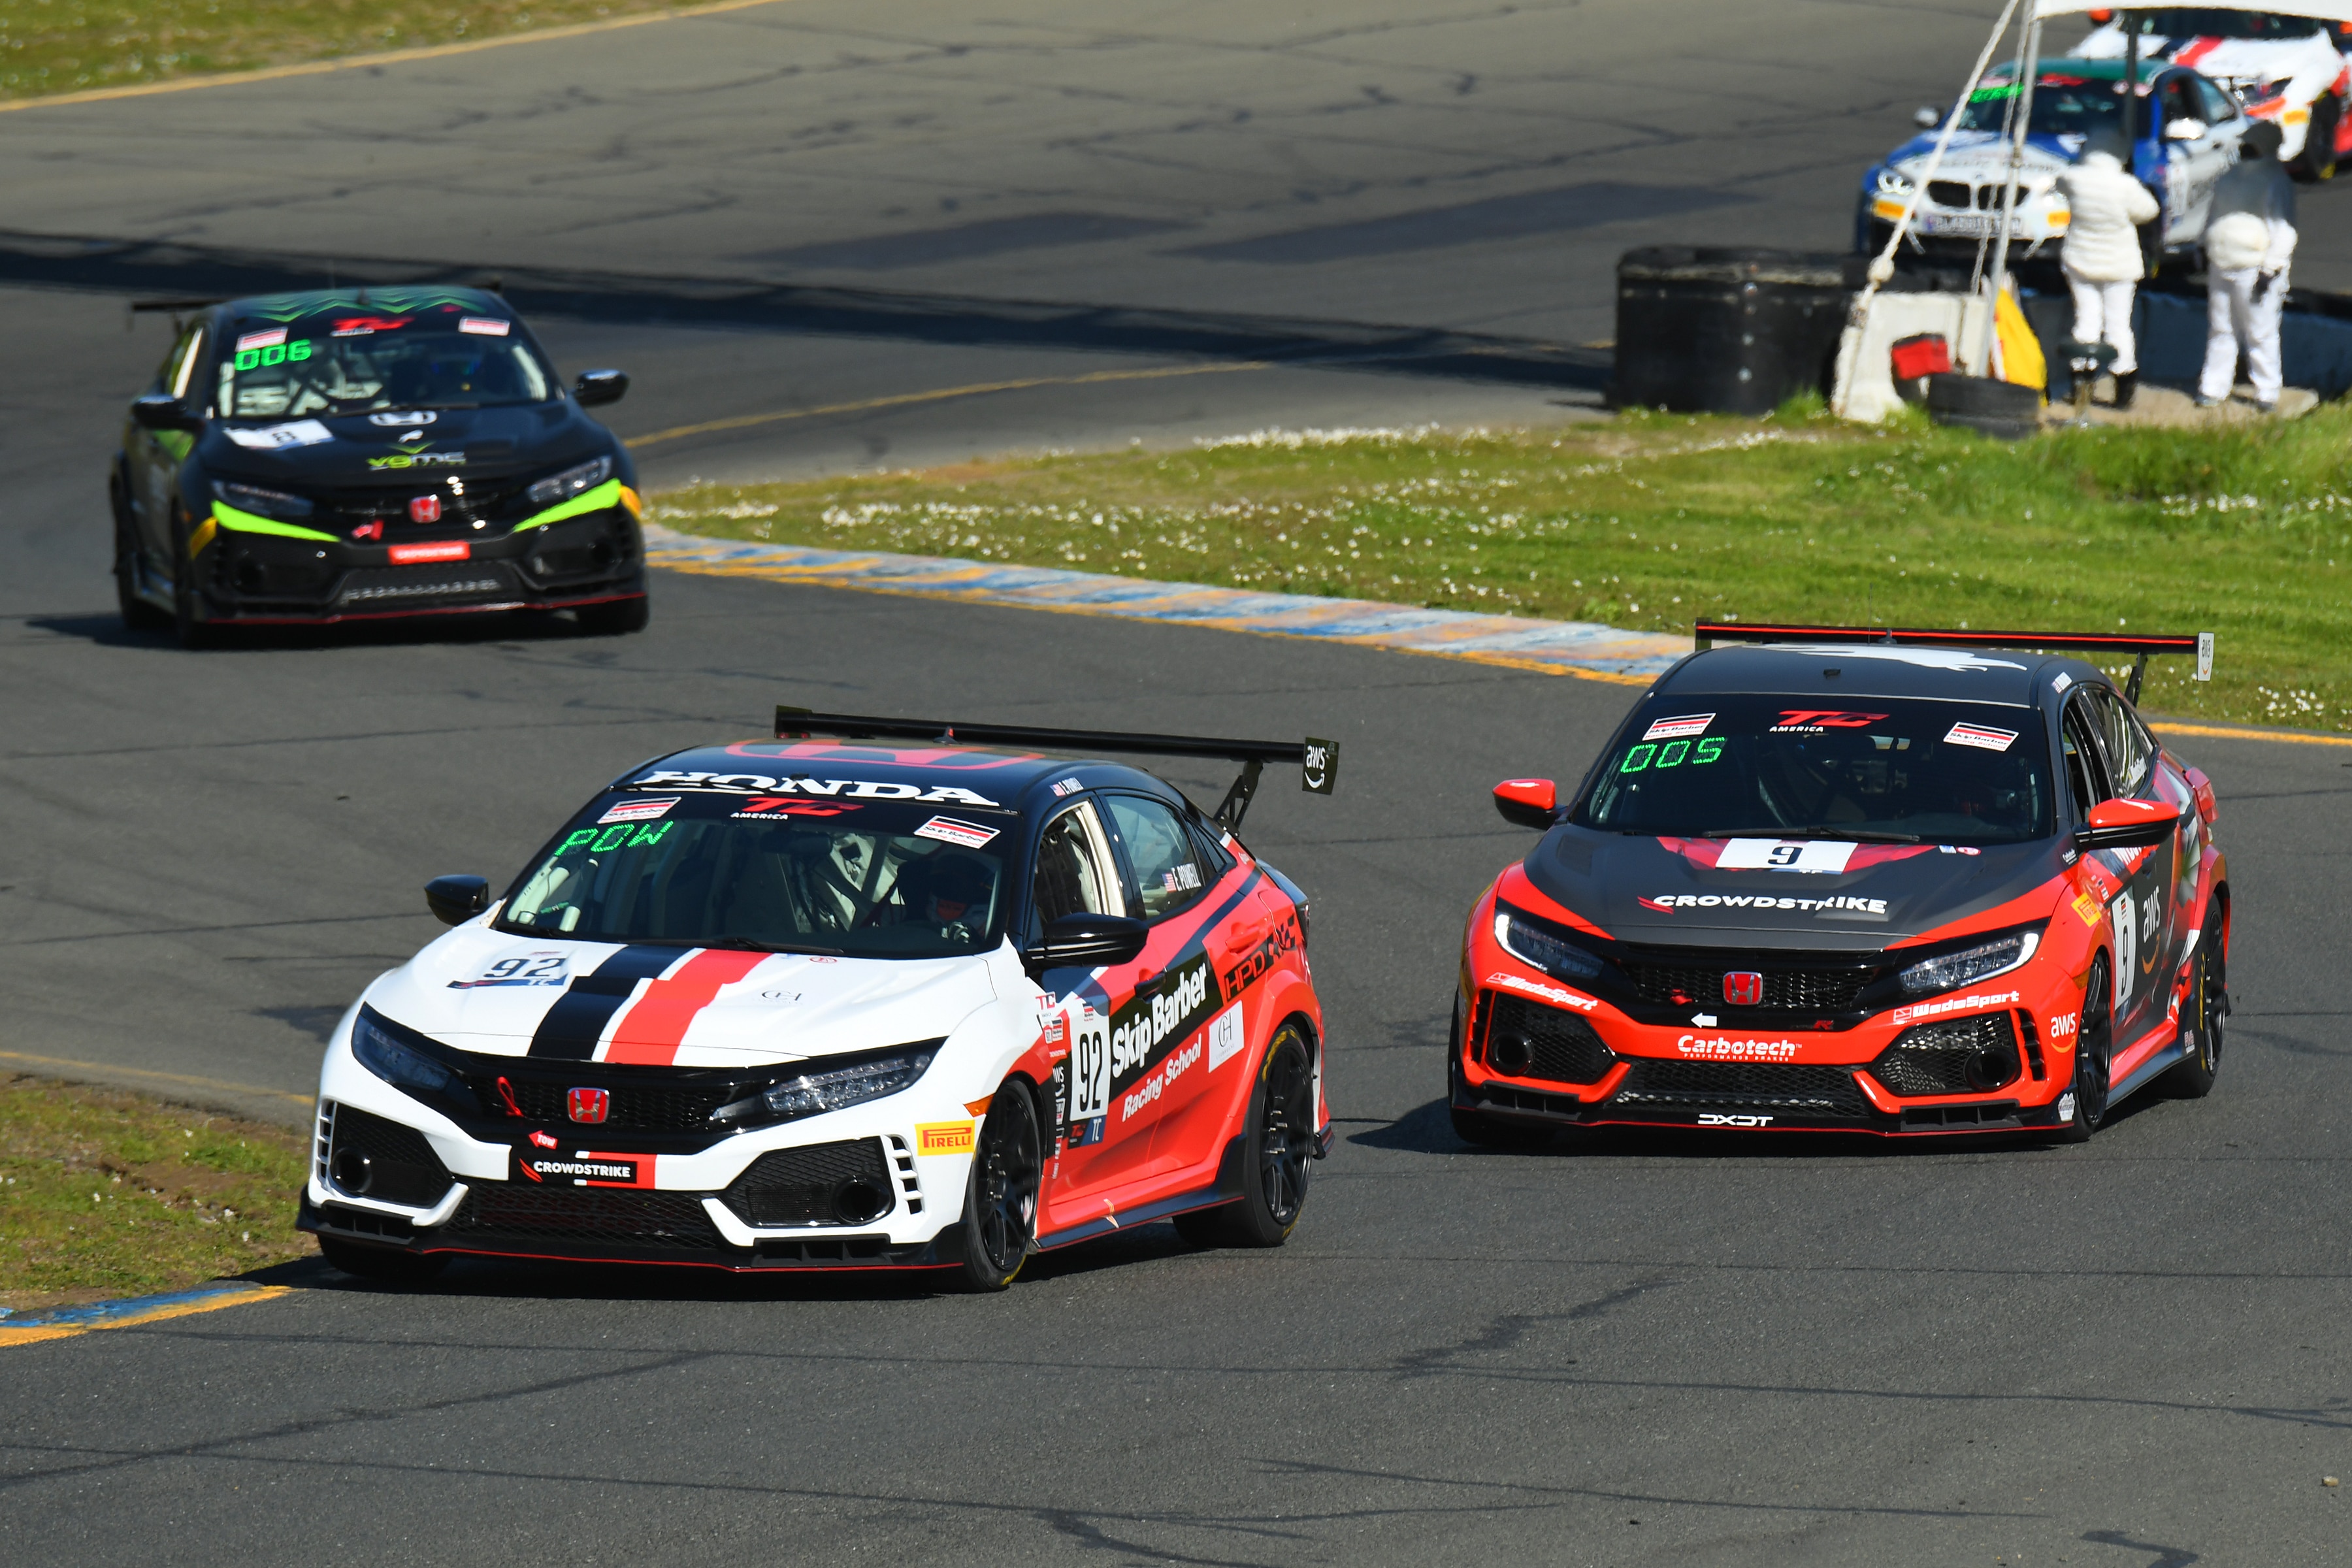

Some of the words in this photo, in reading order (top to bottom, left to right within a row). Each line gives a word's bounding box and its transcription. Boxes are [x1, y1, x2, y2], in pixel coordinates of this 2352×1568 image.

[235, 339, 312, 370] 006
[1778, 710, 1890, 727] TC
[1307, 745, 1326, 770] aws
[632, 770, 1000, 807] HONDA
[730, 811, 789, 821] AMERICA
[742, 797, 865, 817] TC
[554, 820, 674, 853] POW
[1768, 847, 1803, 865] 9
[1653, 894, 1889, 915] CROWDSTRIKE
[2143, 885, 2161, 943] aws
[483, 958, 567, 977] 92
[2121, 924, 2129, 998] 9
[1226, 951, 1266, 1000] HPD
[1112, 1012, 1152, 1079] Skip
[1152, 962, 1207, 1046] Barber
[2050, 1012, 2076, 1038] aws
[1677, 1034, 1796, 1056] Carbotech
[1079, 1031, 1103, 1113] 92
[1122, 1073, 1163, 1122] Racing
[1165, 1032, 1201, 1086] School
[536, 1134, 555, 1147] TOW
[923, 1127, 972, 1149] PIRELLI
[532, 1160, 631, 1178] CROWDSTRIKE
